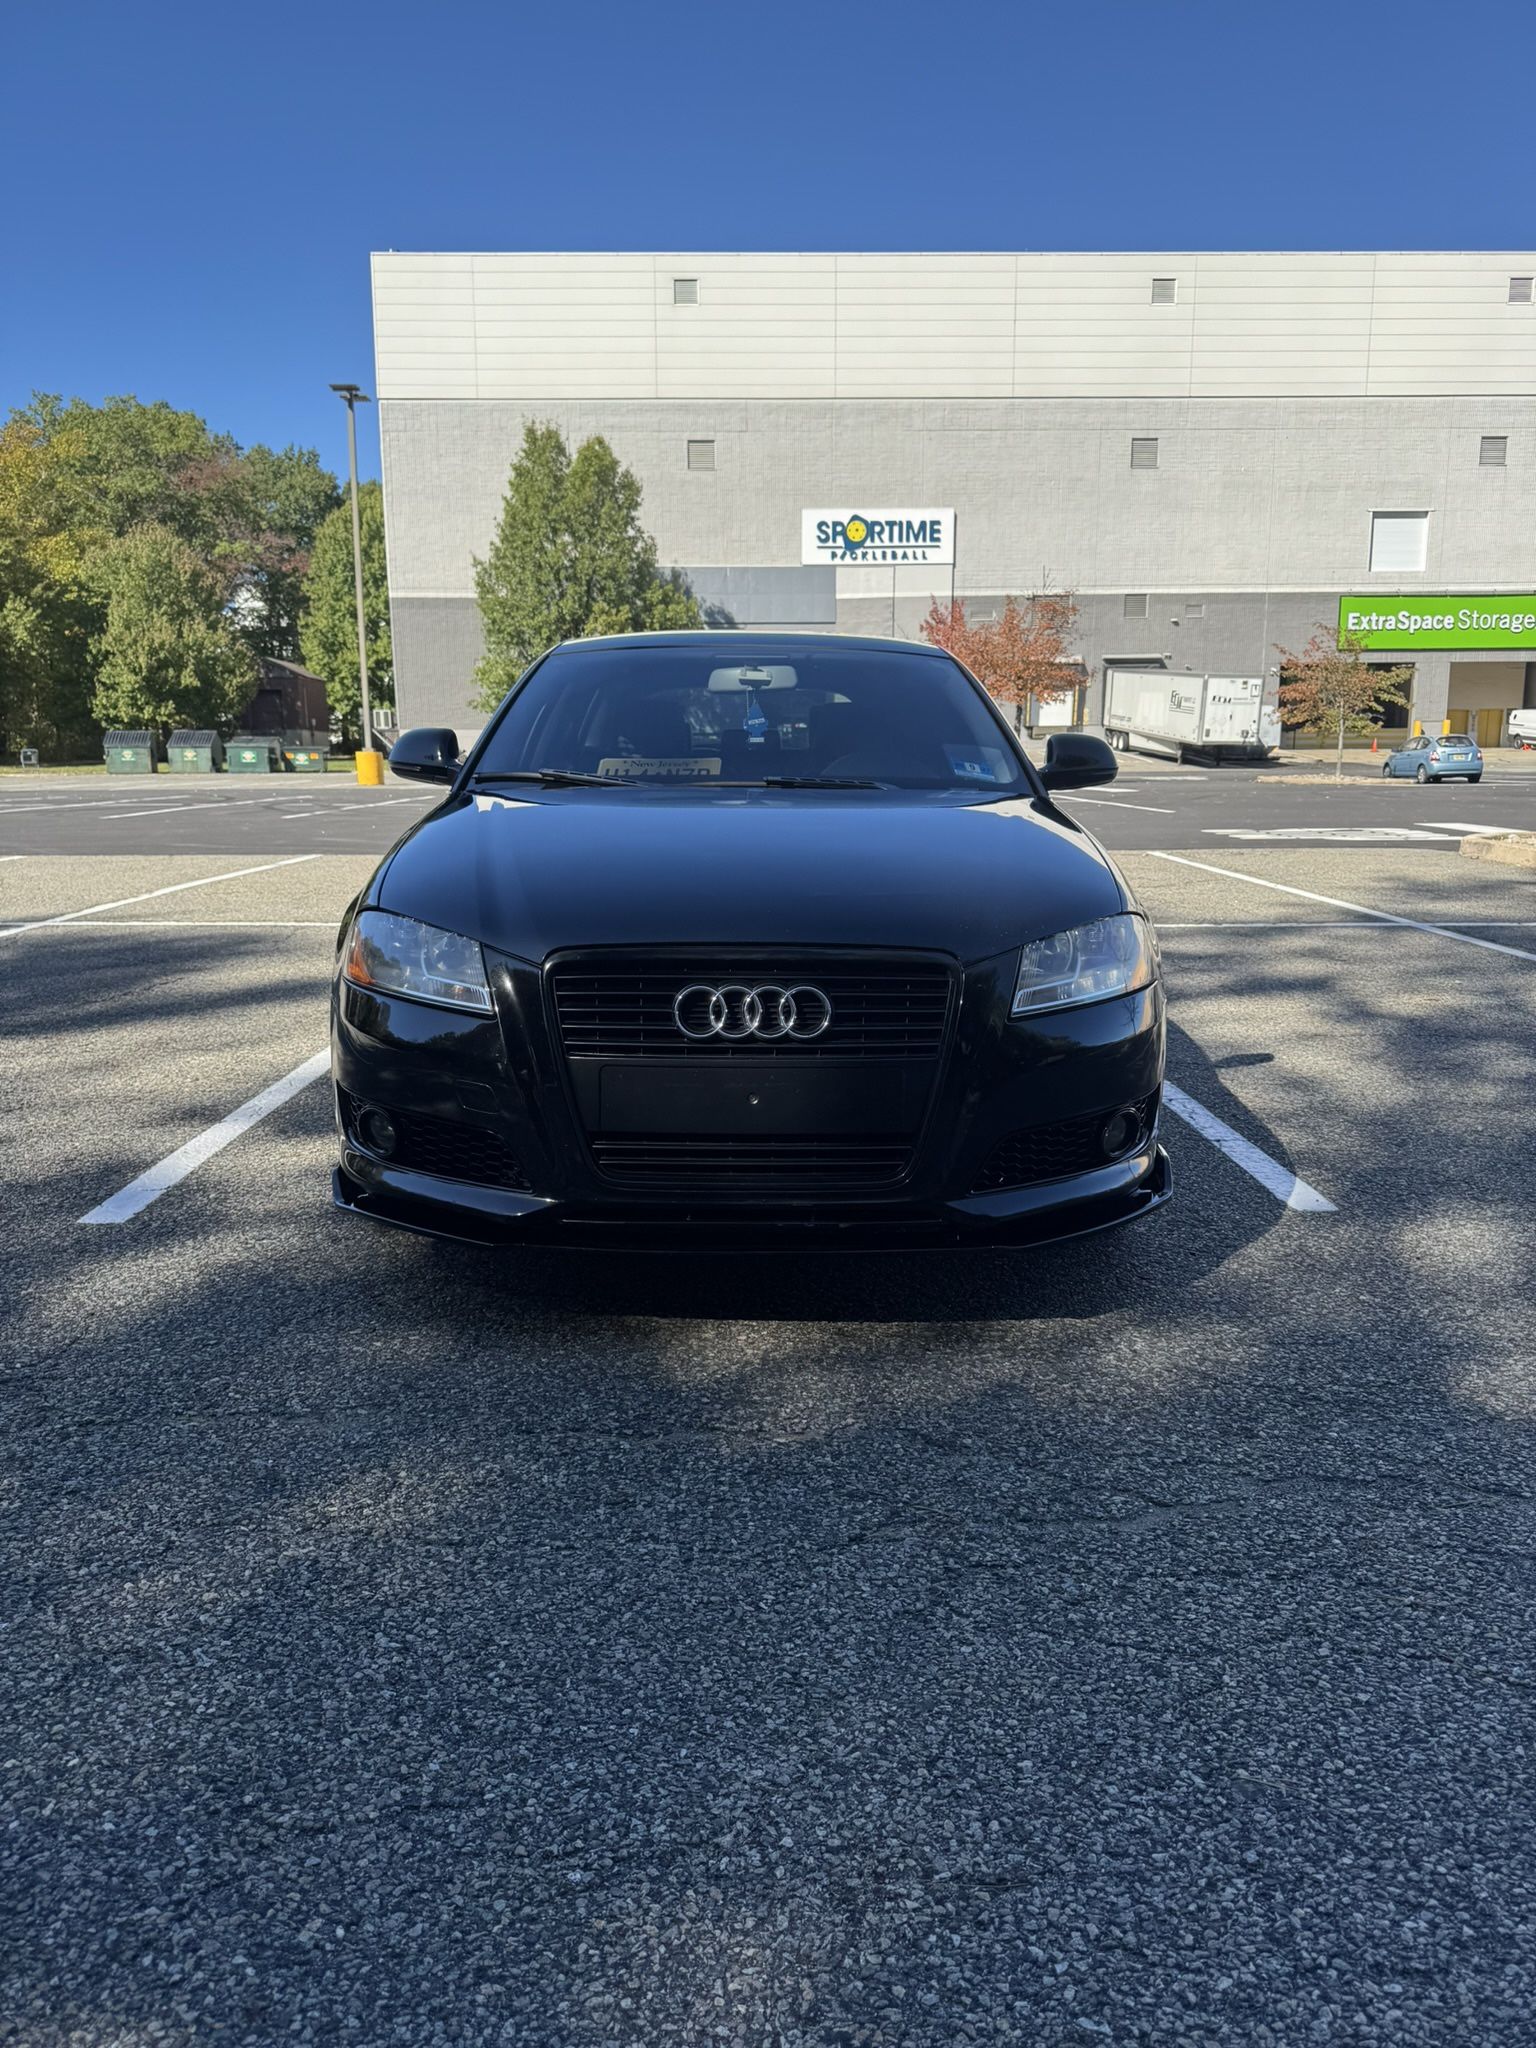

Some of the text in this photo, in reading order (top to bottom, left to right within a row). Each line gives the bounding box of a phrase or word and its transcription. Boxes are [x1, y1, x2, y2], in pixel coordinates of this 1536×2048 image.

[816, 514, 942, 544] SPORTIME
[830, 550, 928, 561] PICKLEBALL
[1457, 608, 1536, 633] Storage
[630, 760, 655, 768] New
